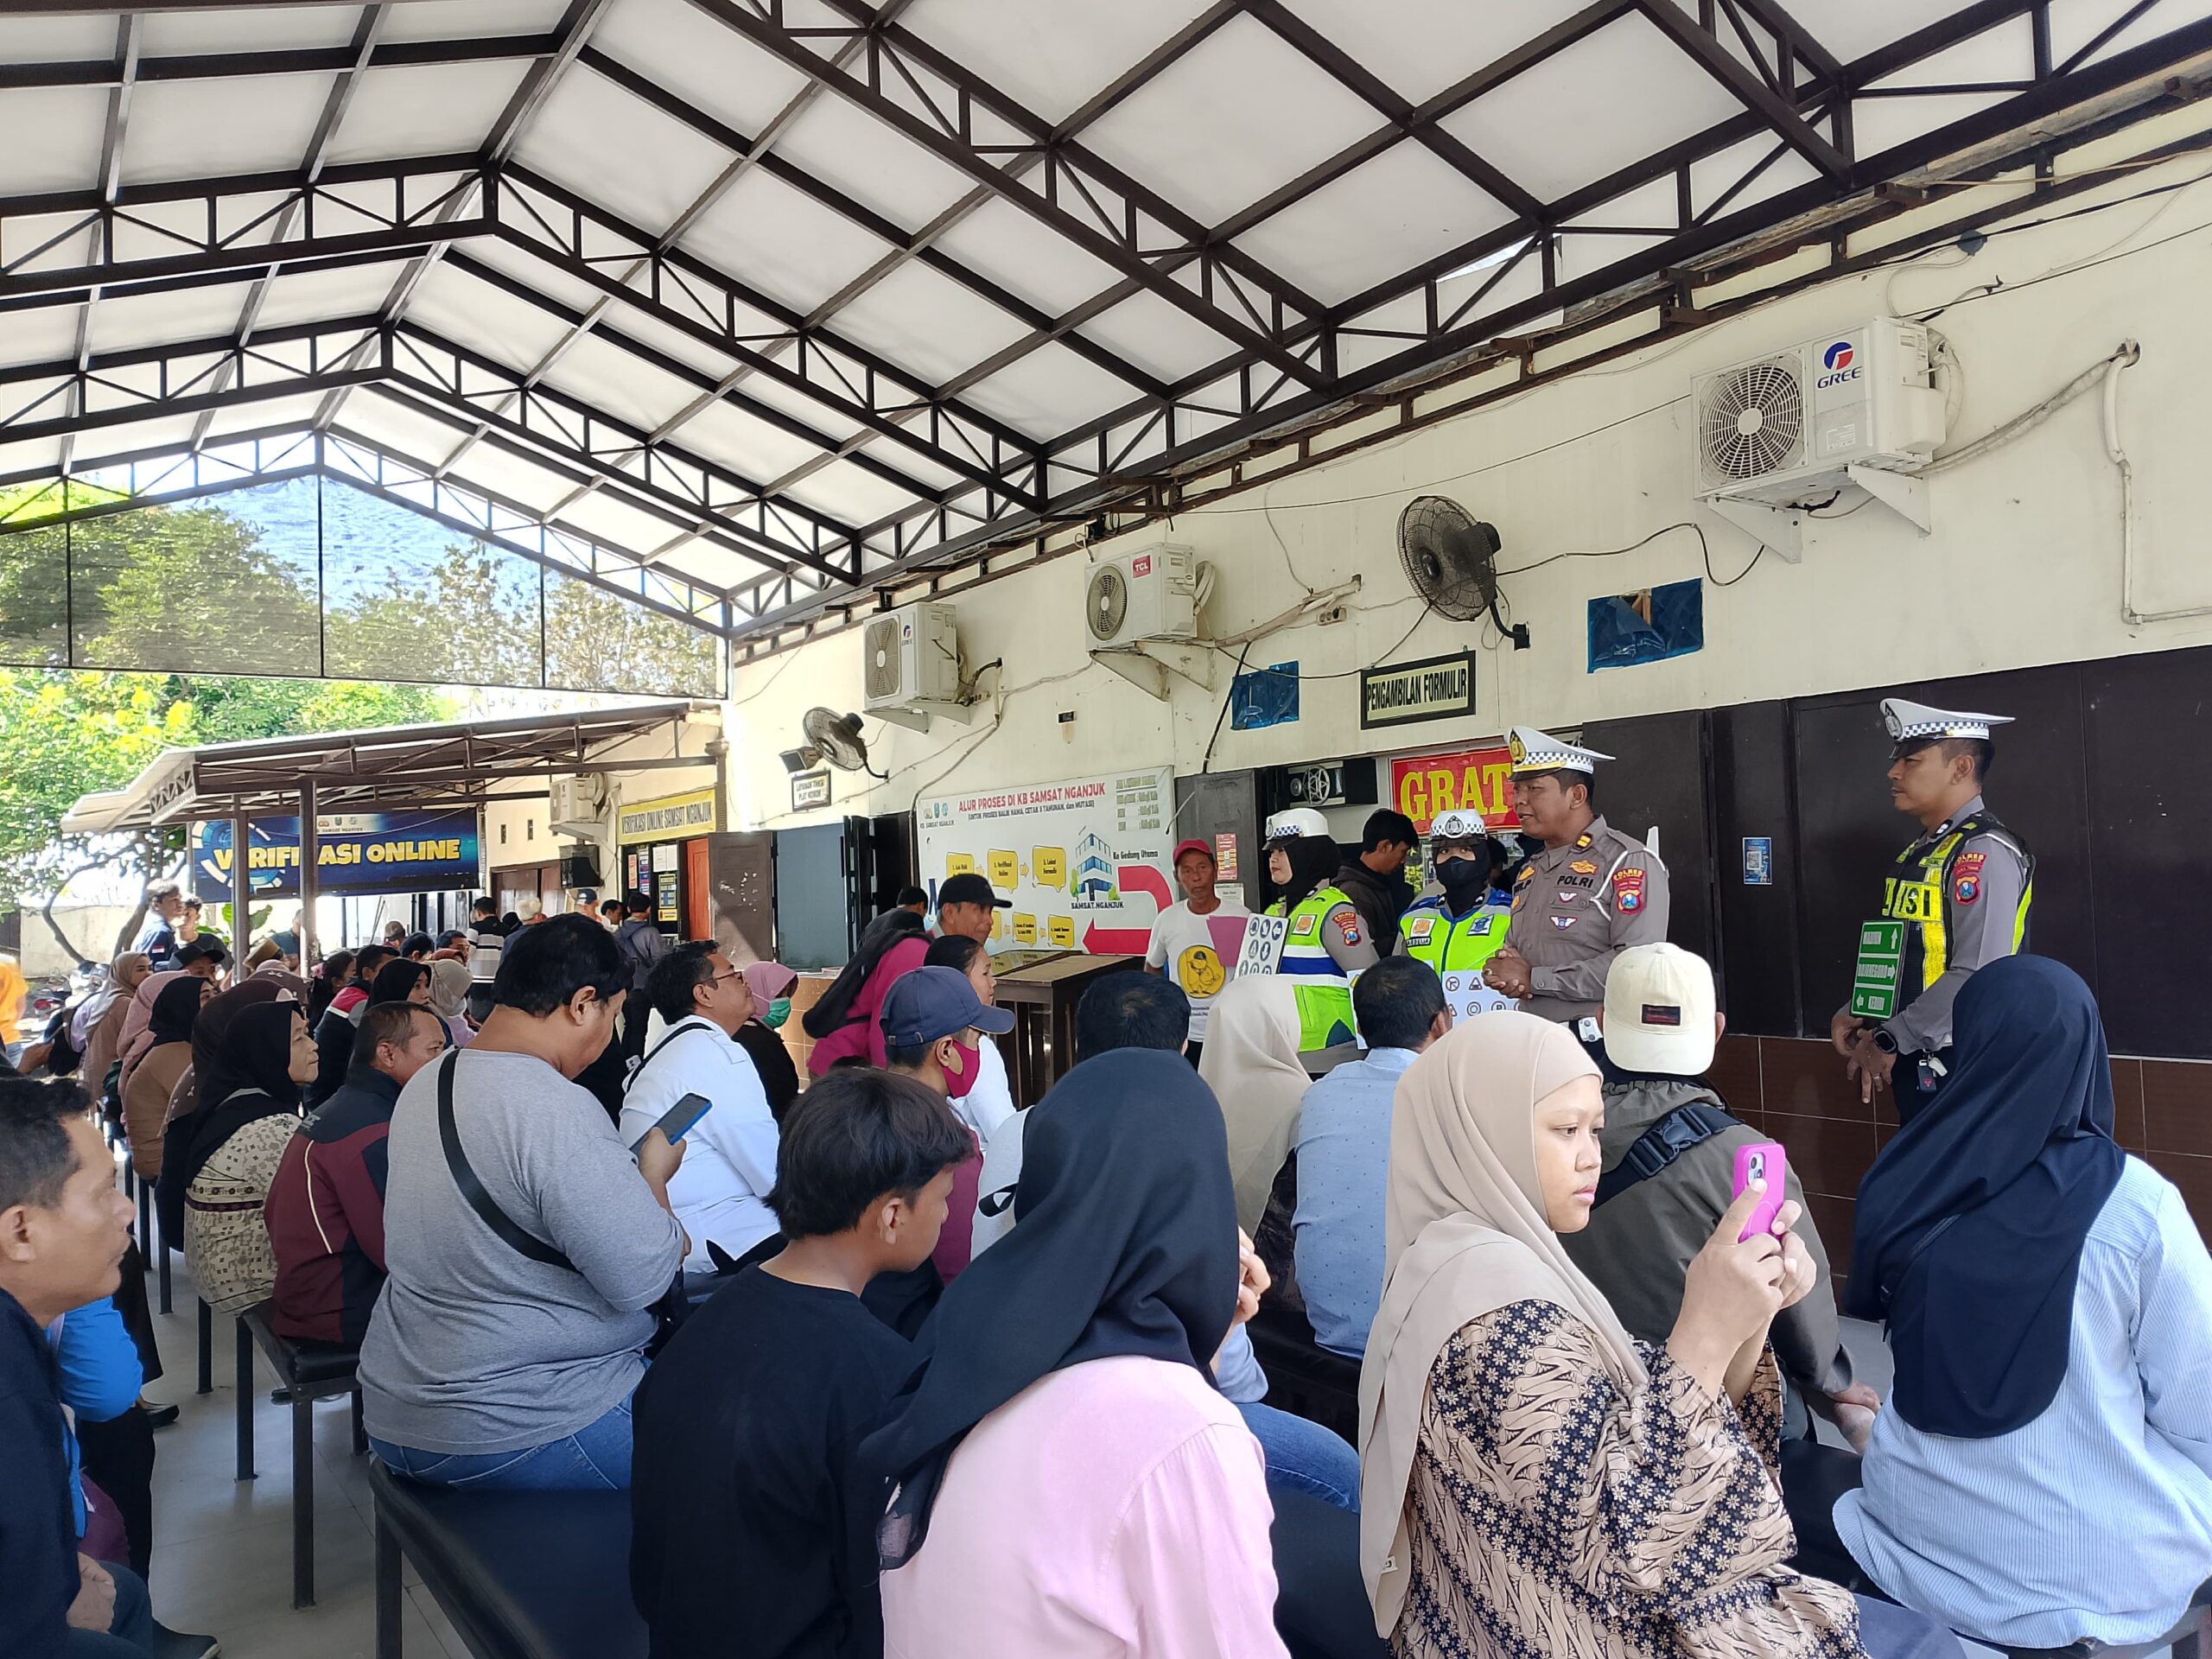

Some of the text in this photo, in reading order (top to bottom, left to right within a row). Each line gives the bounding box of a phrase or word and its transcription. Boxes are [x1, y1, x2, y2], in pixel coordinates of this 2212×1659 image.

[1816, 365, 1863, 390] GREE
[1135, 562, 1148, 572] TCL
[1367, 668, 1467, 711] PENGAMBILAN FORMULIR
[959, 799, 976, 812] ALUR
[978, 795, 1006, 810] PROSES
[1007, 793, 1015, 806] DI
[1018, 792, 1027, 804] KB
[1030, 788, 1062, 804] SAMSAT
[1065, 783, 1105, 799] NGANJUK
[1400, 763, 1512, 823] GRAT
[621, 801, 712, 835] VERIFIKASI ONLINE SAMSAT NGANJUK
[213, 839, 460, 870] VRIFIASI ONLINE
[1121, 850, 1140, 860] Gedung
[1557, 875, 1594, 889] POLRI
